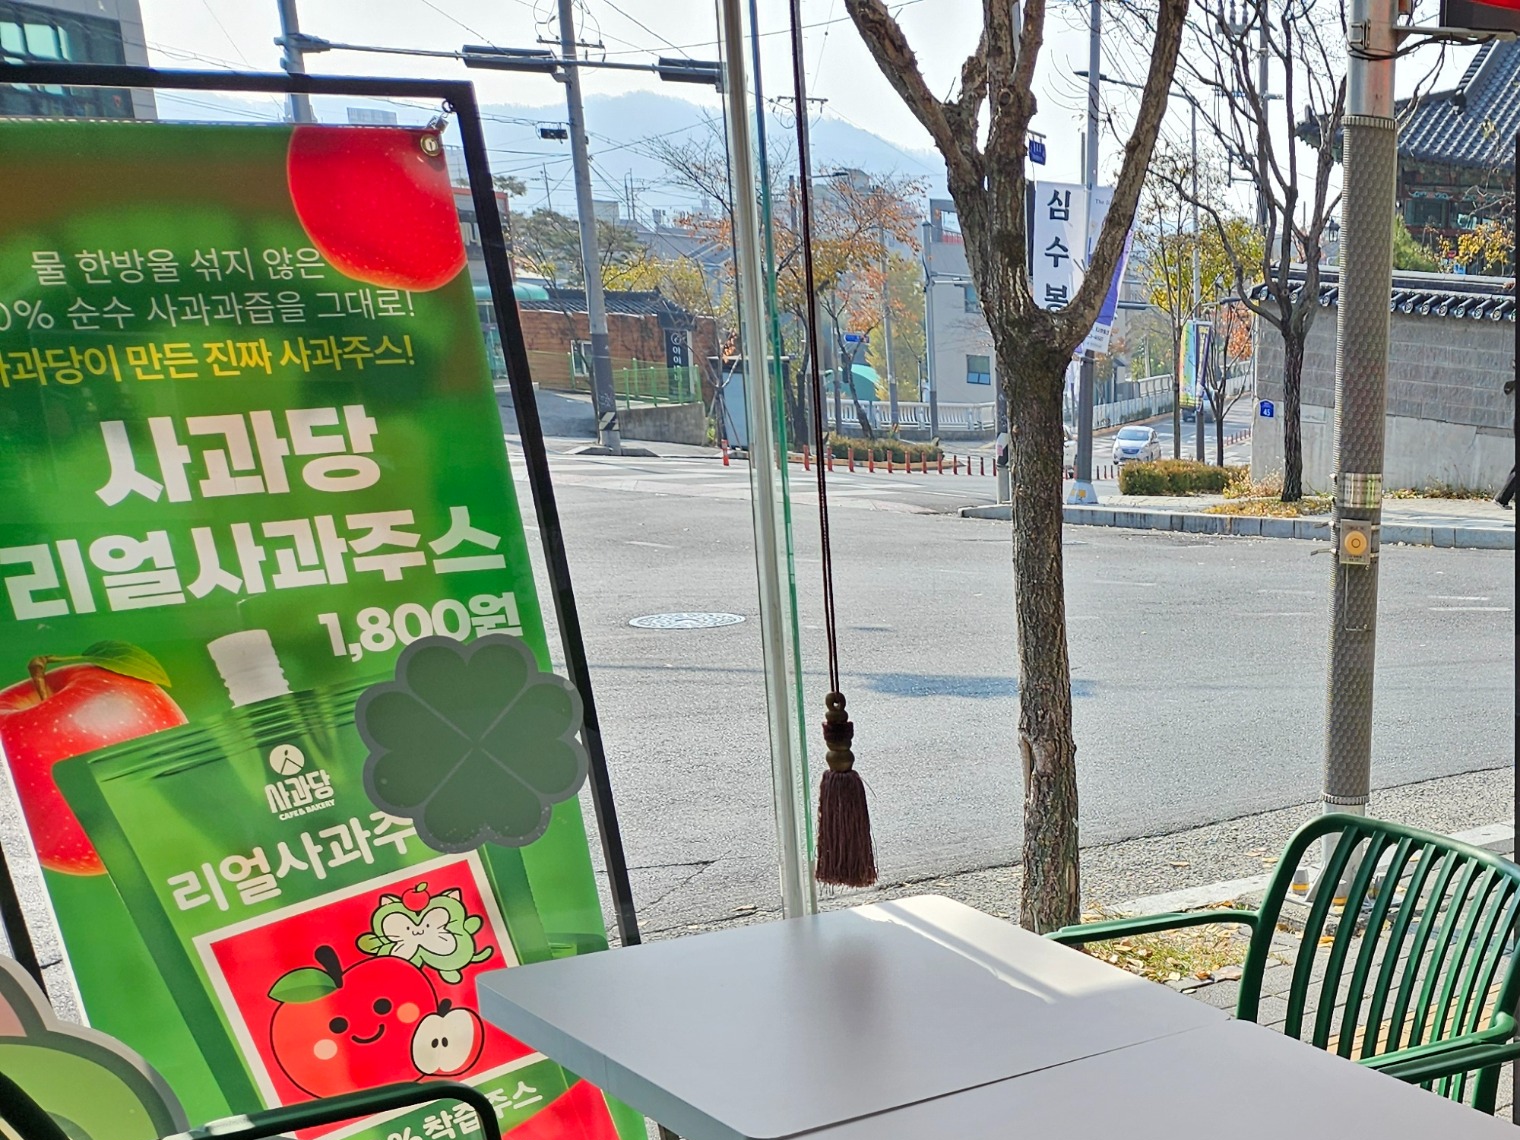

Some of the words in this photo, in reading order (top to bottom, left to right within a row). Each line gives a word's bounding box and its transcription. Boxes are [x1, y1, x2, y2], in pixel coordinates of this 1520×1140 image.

[31, 250, 67, 286] 물
[74, 249, 180, 285] 한방울
[190, 247, 255, 282] 섞지
[262, 247, 325, 280] 않은
[67, 296, 135, 330] 순수
[147, 291, 306, 328] 사과과즙을
[315, 288, 416, 320] 그대로!
[126, 342, 199, 380] 만든
[205, 338, 272, 377] 진짜
[279, 335, 416, 372] 사과주스!
[95, 404, 381, 507] 사과당
[0, 505, 507, 621] 리얼사과주스
[318, 592, 524, 662] 1,800원
[264, 769, 334, 813] 사과당
[306, 799, 335, 814] BAKERY
[167, 811, 417, 914] 리얼사과주
